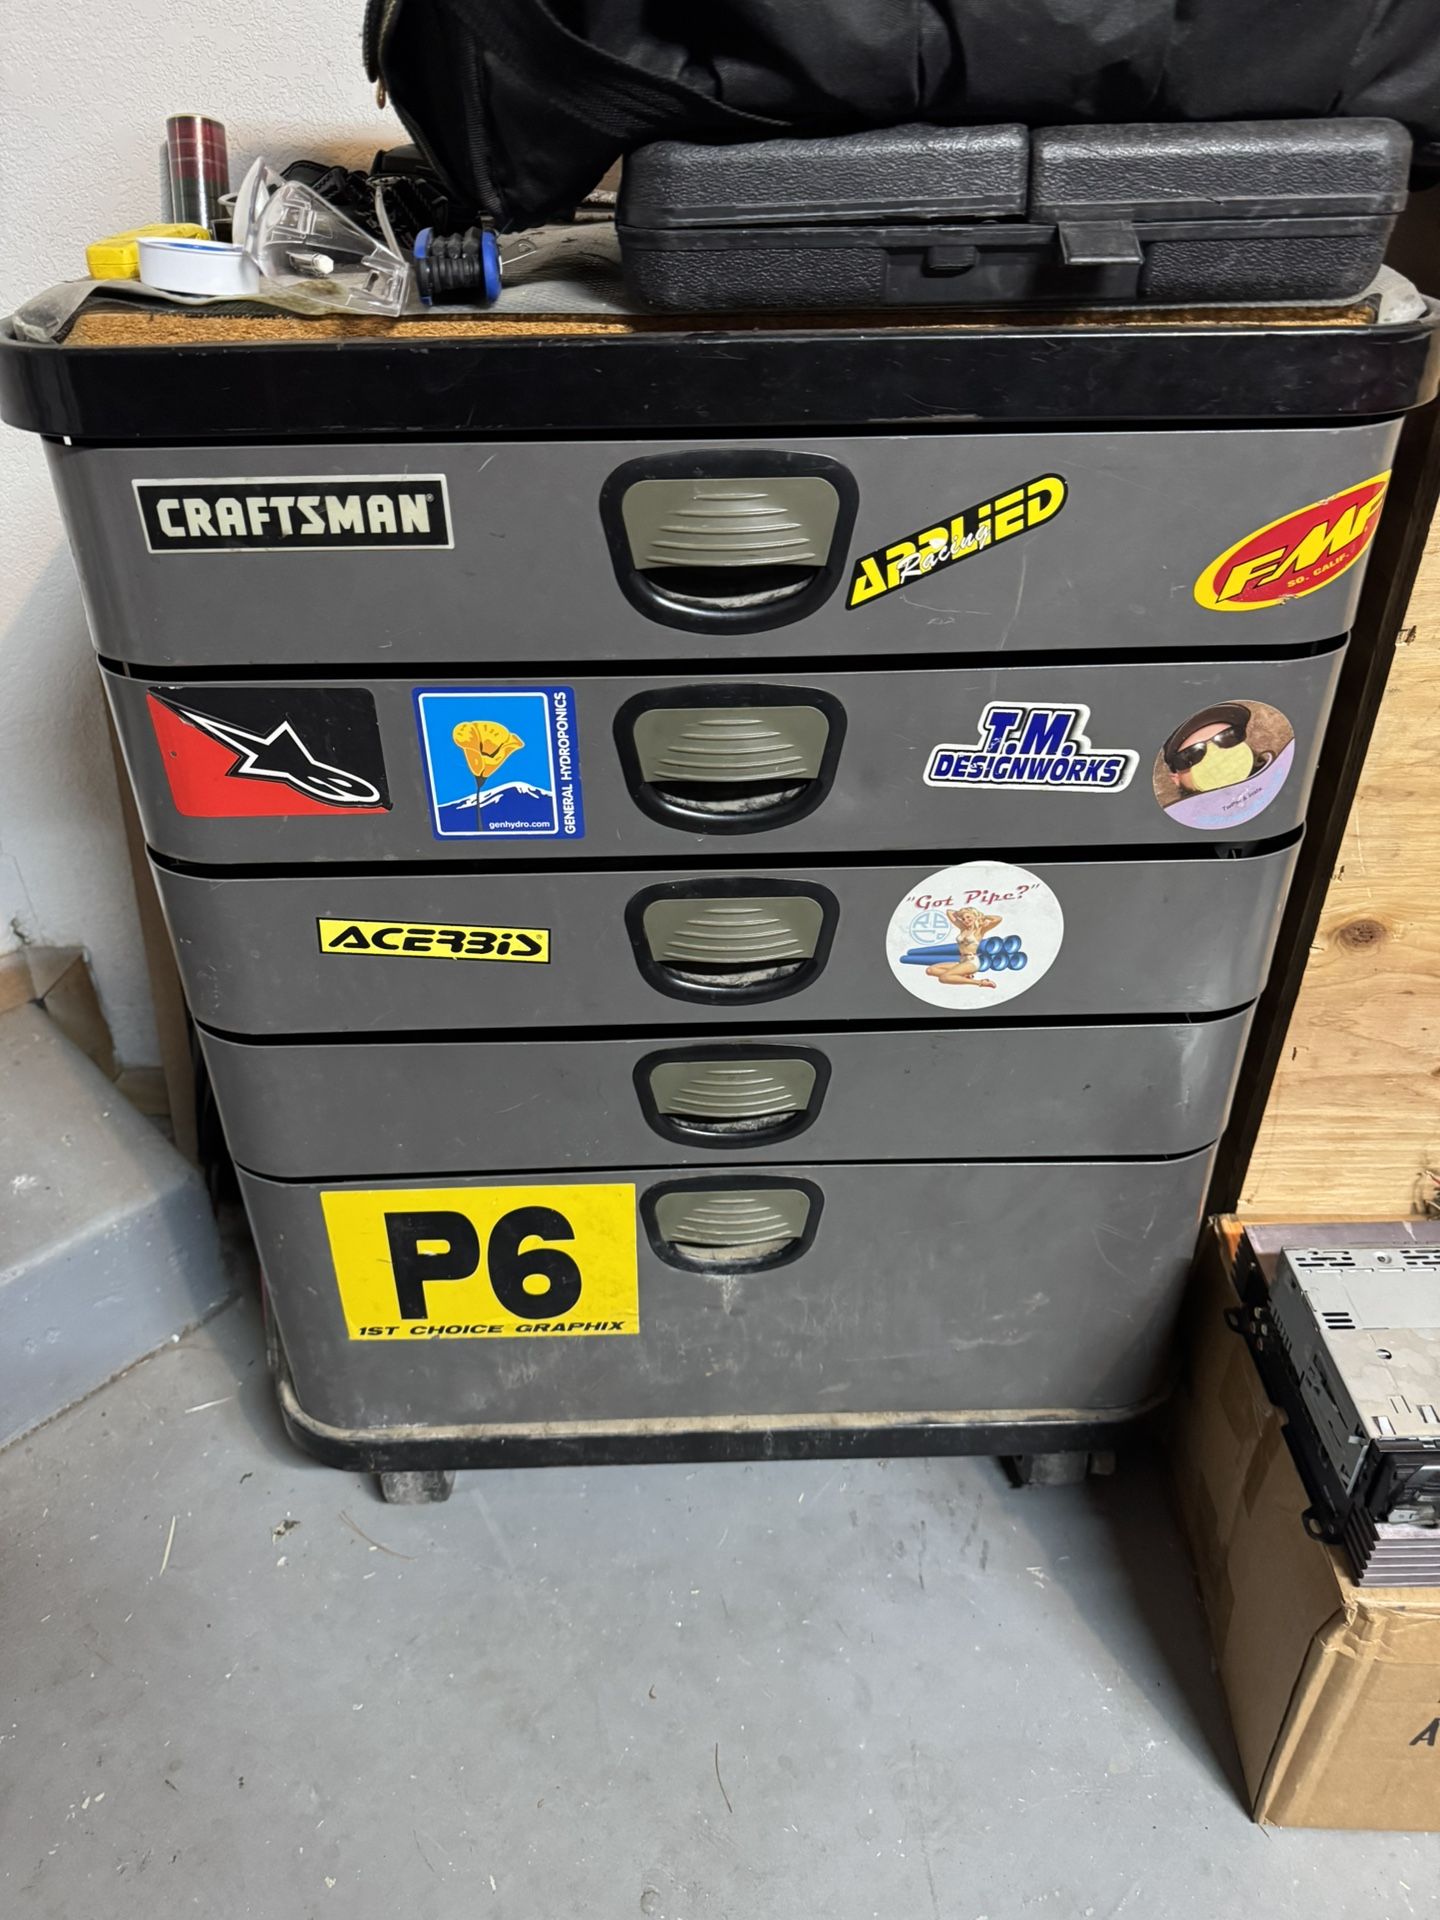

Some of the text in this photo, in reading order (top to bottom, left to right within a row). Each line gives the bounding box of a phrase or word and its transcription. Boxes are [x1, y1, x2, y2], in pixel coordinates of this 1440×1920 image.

[156, 494, 431, 537] CRAFTSMAN
[896, 523, 991, 584] Racing
[1286, 552, 1350, 588] SO. CALIF.
[985, 711, 1075, 757] T.M.
[553, 691, 577, 835] GENERAL HYDROPONICS
[933, 753, 1122, 783] DESIGNWORKS
[488, 820, 551, 830] genhydro.com
[384, 1205, 582, 1320] P6
[359, 1320, 626, 1336] 1ST CHOICE GRAPHIX
